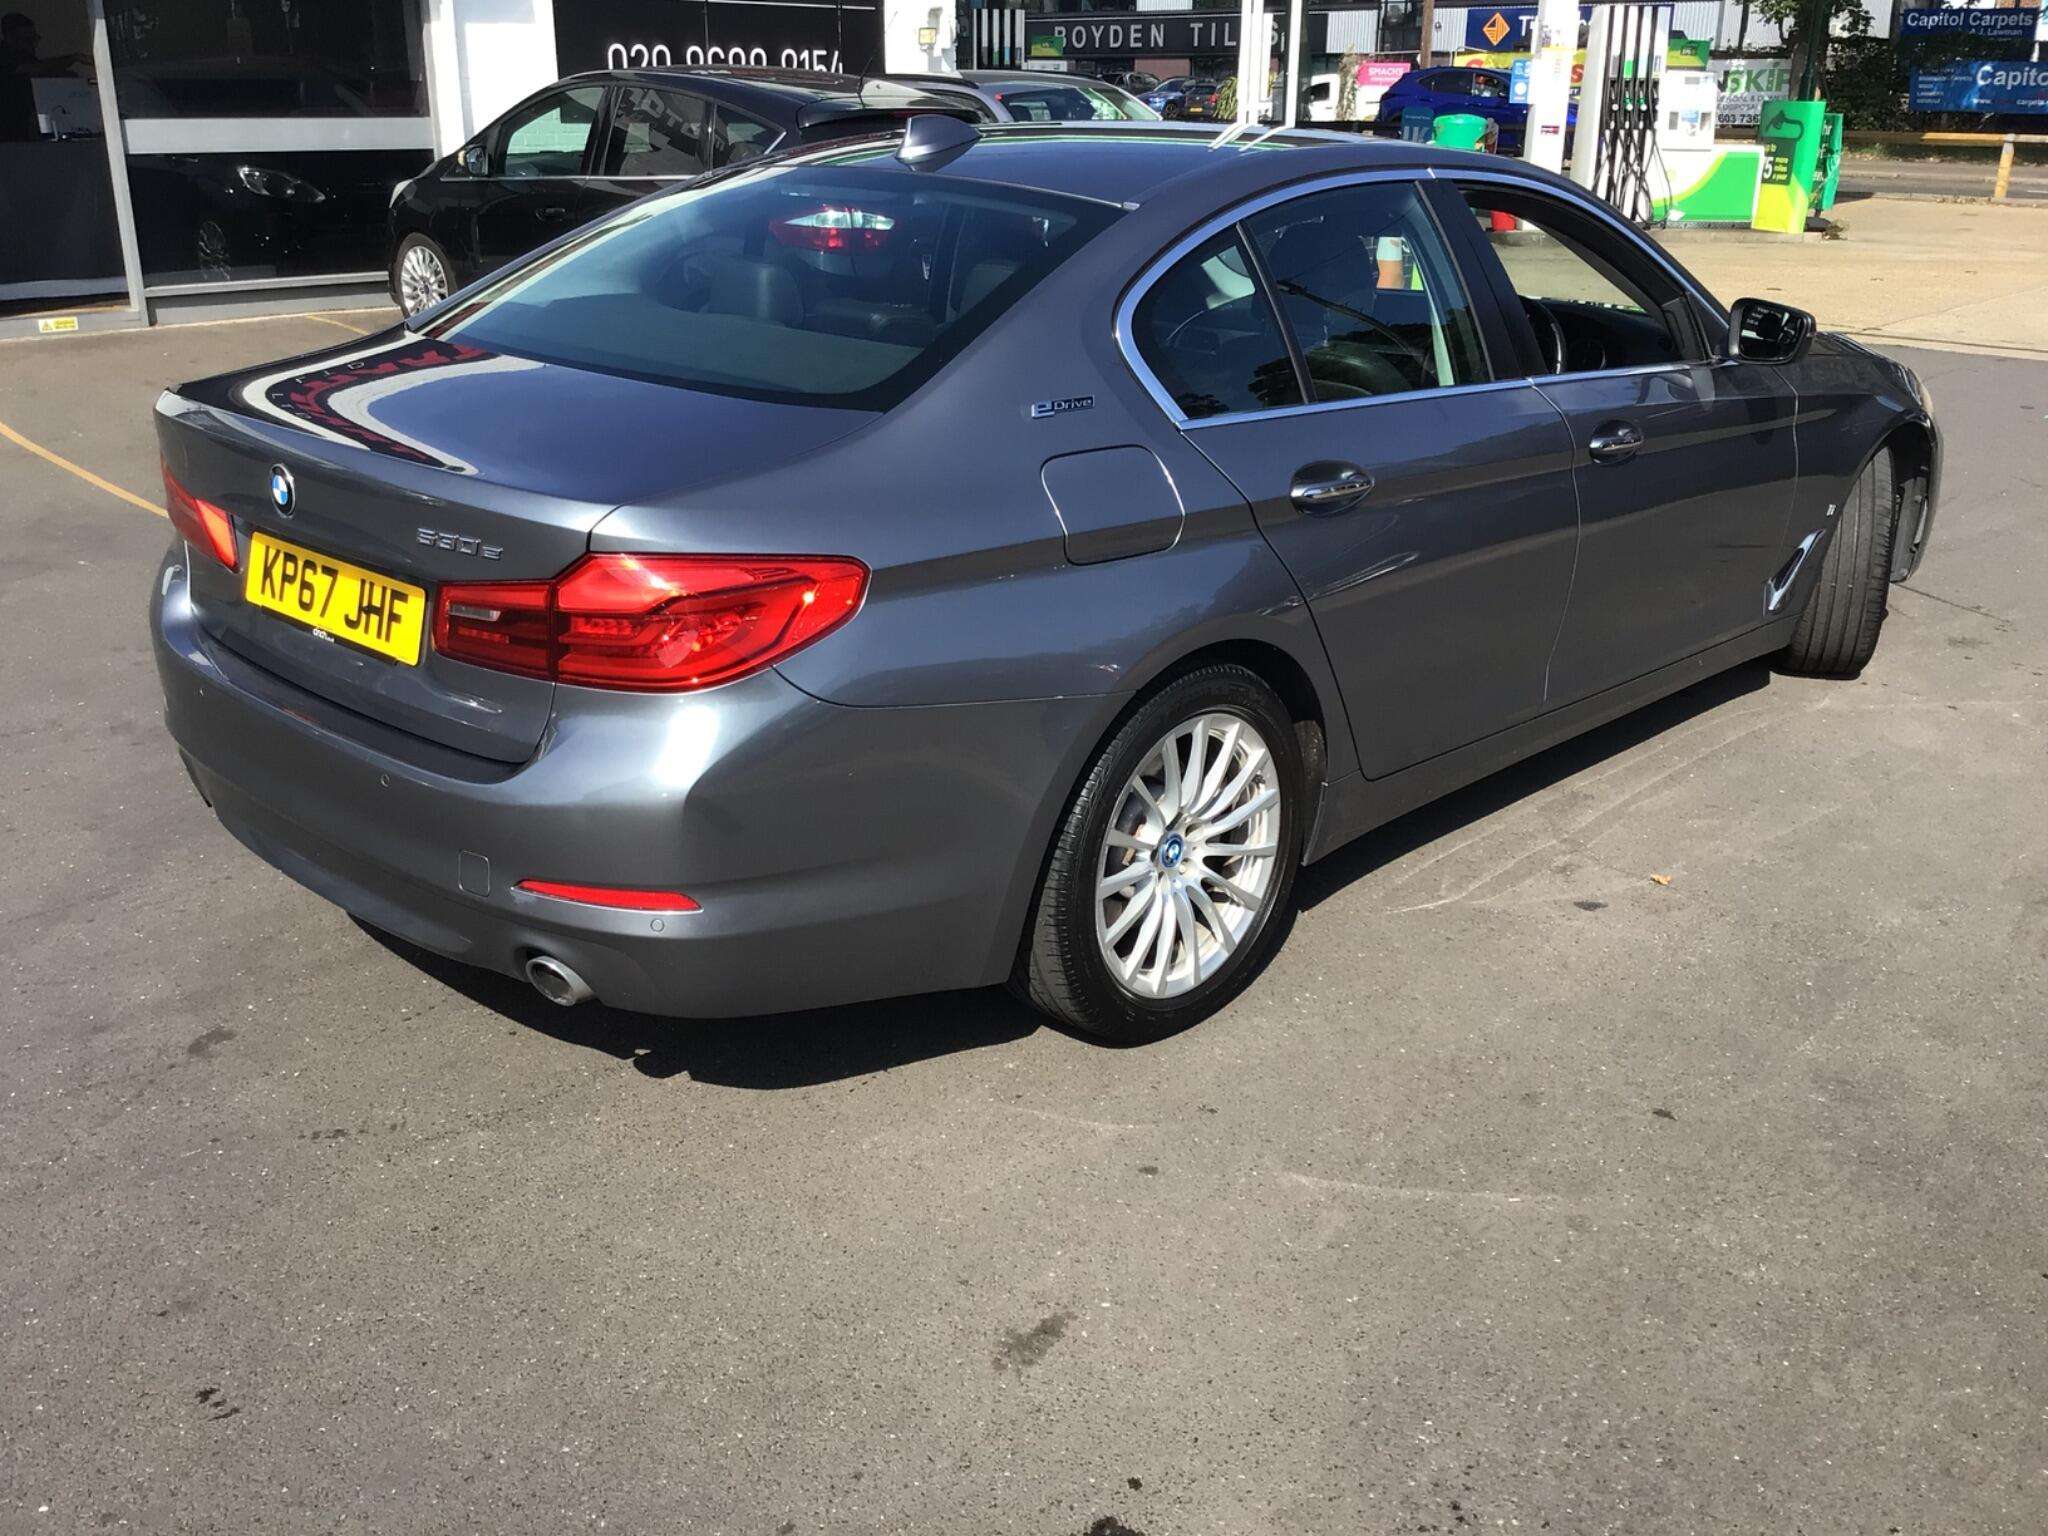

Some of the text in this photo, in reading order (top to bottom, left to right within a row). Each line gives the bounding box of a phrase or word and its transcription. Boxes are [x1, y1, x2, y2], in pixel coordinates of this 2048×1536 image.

[1906, 11, 2034, 30] Capitol Carpets
[1054, 22, 1279, 48] BOYDEN TILS
[261, 545, 409, 643] KP67 JHF
